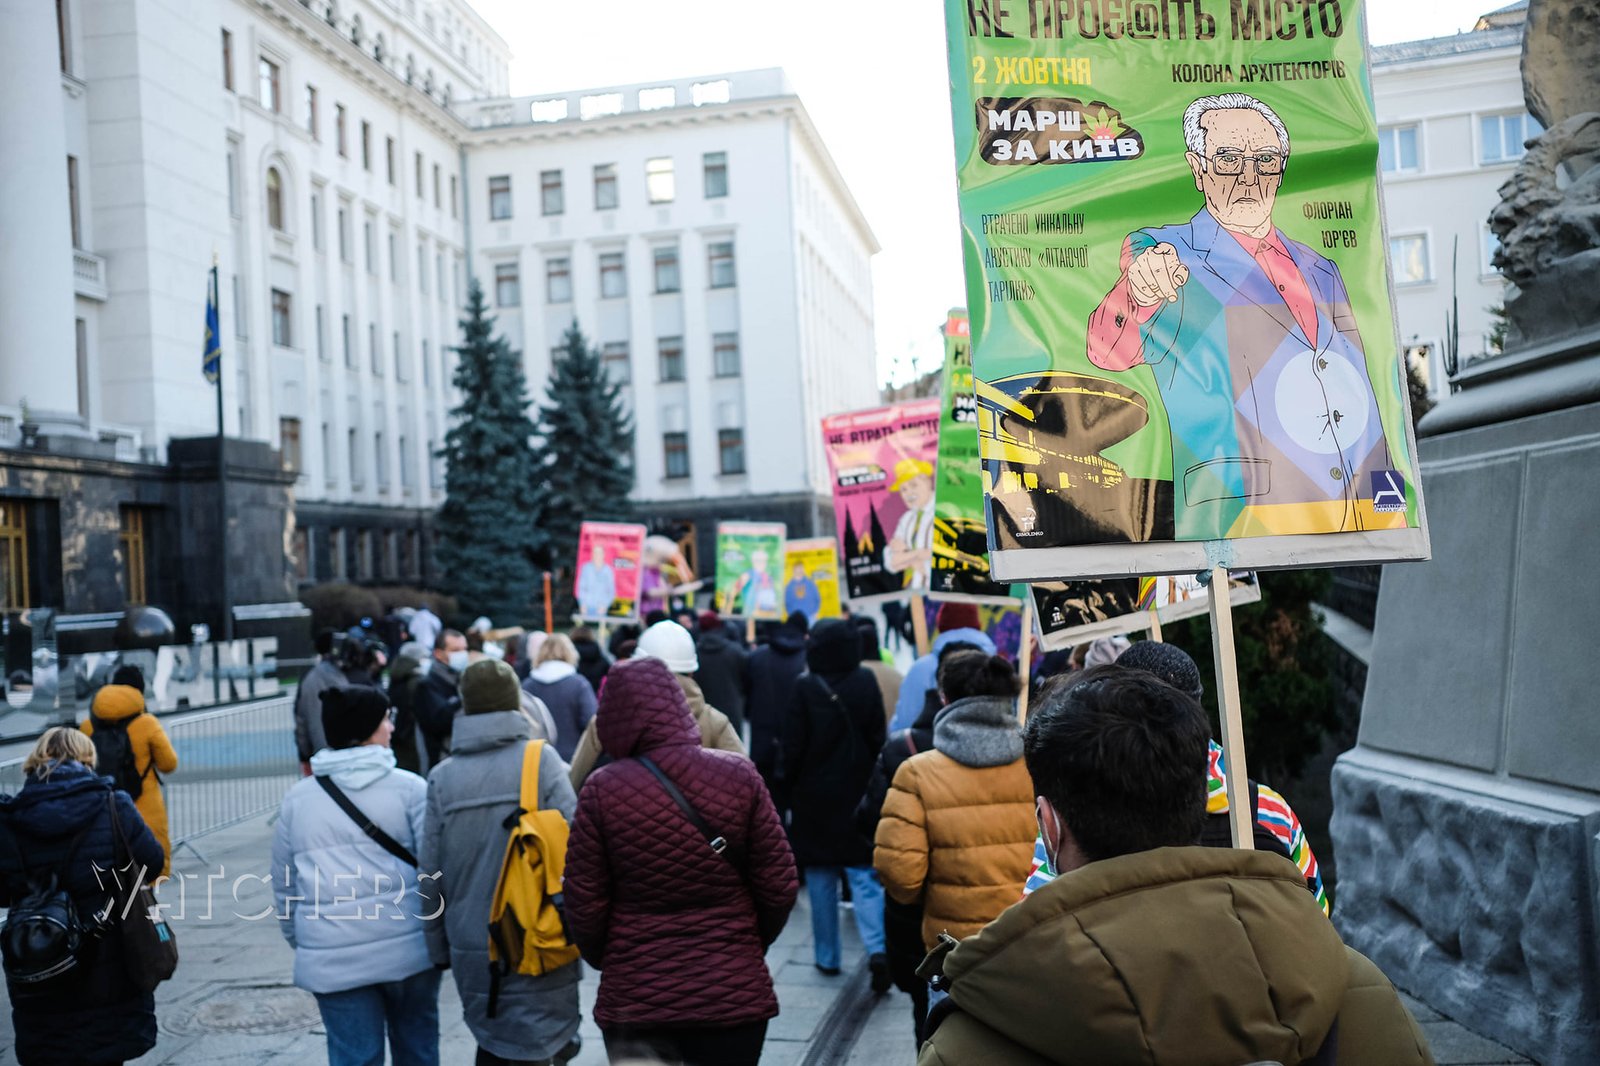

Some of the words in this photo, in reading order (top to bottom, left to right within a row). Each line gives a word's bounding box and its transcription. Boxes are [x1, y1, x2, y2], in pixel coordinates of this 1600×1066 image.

[967, 0, 1014, 37] НЕ
[1230, 0, 1344, 41] МІСТО
[972, 57, 987, 84] 2
[994, 56, 1093, 85] ЖОВТНЯ
[1172, 64, 1235, 83] КОЛОНА
[1240, 60, 1347, 82] АРХІТЕКТОРІВ
[988, 110, 1080, 132] МАРШ
[992, 139, 1037, 161] ЗА
[1050, 135, 1140, 160] КИЇВ
[1302, 201, 1353, 220] ФЛОРІАН
[982, 213, 1029, 235] ВТРАЧЕНО
[1035, 213, 1084, 235] УНІКАЛЬНУ
[985, 247, 1031, 268] АКУСТИКУ
